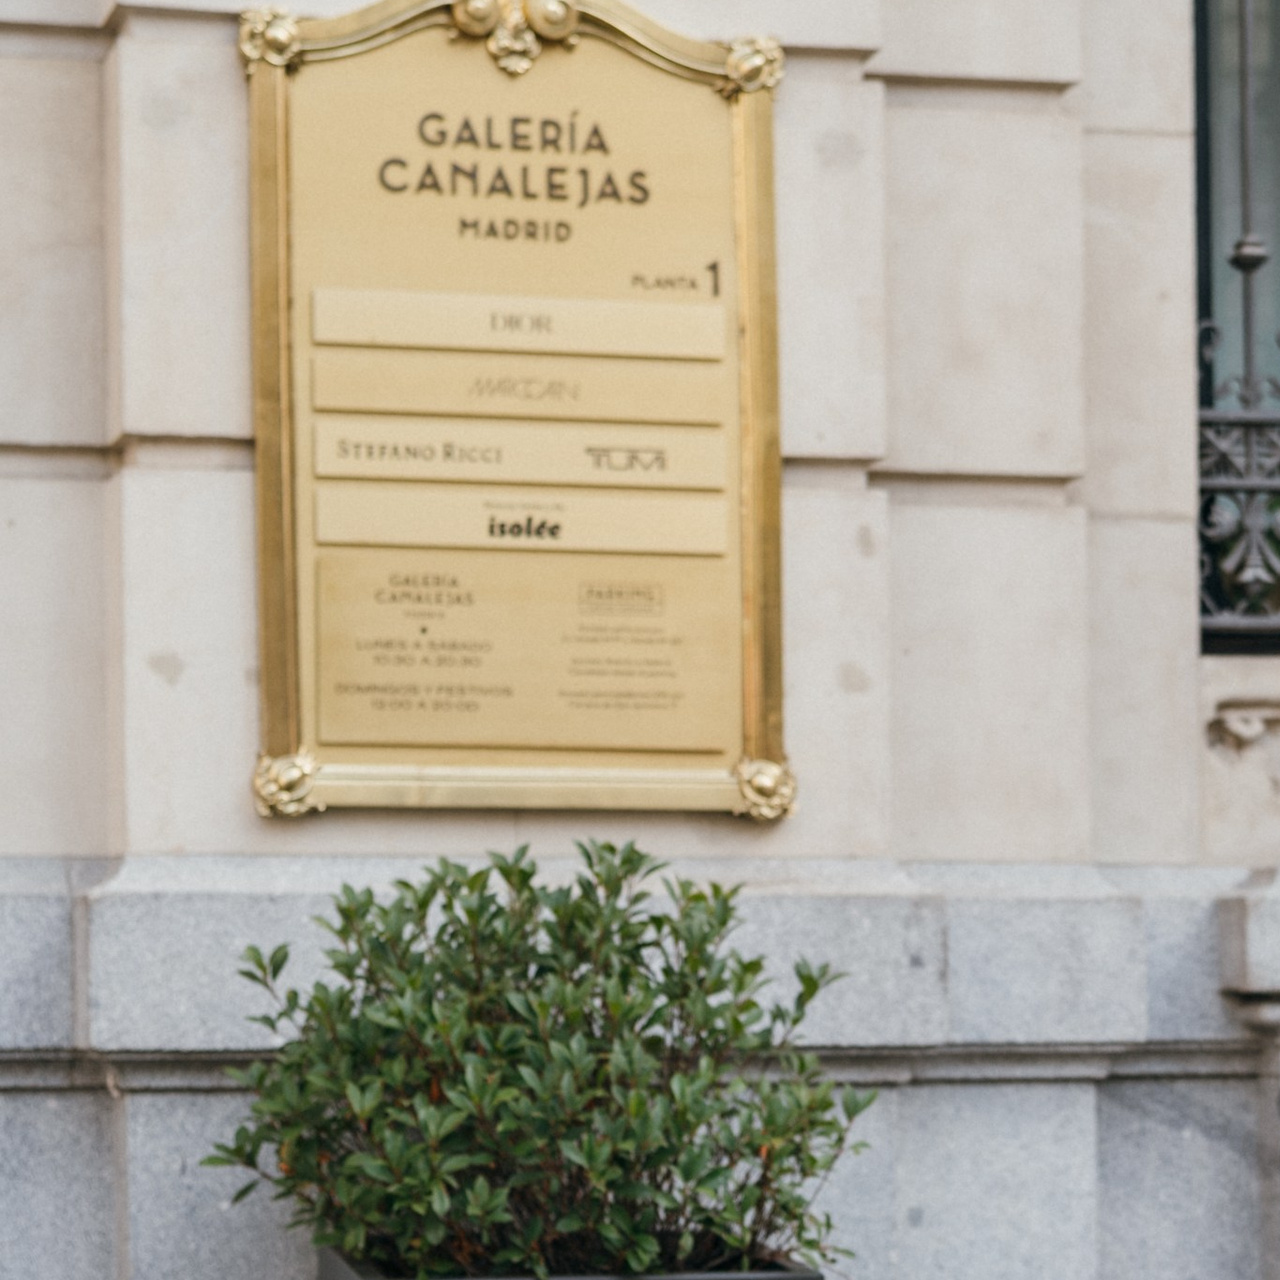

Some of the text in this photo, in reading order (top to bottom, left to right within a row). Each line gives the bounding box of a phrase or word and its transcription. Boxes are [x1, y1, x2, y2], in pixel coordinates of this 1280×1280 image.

[416, 109, 611, 156] GALERÍA
[377, 157, 651, 210] CANALEJAS
[458, 217, 573, 244] MADRID
[705, 260, 722, 299] 1
